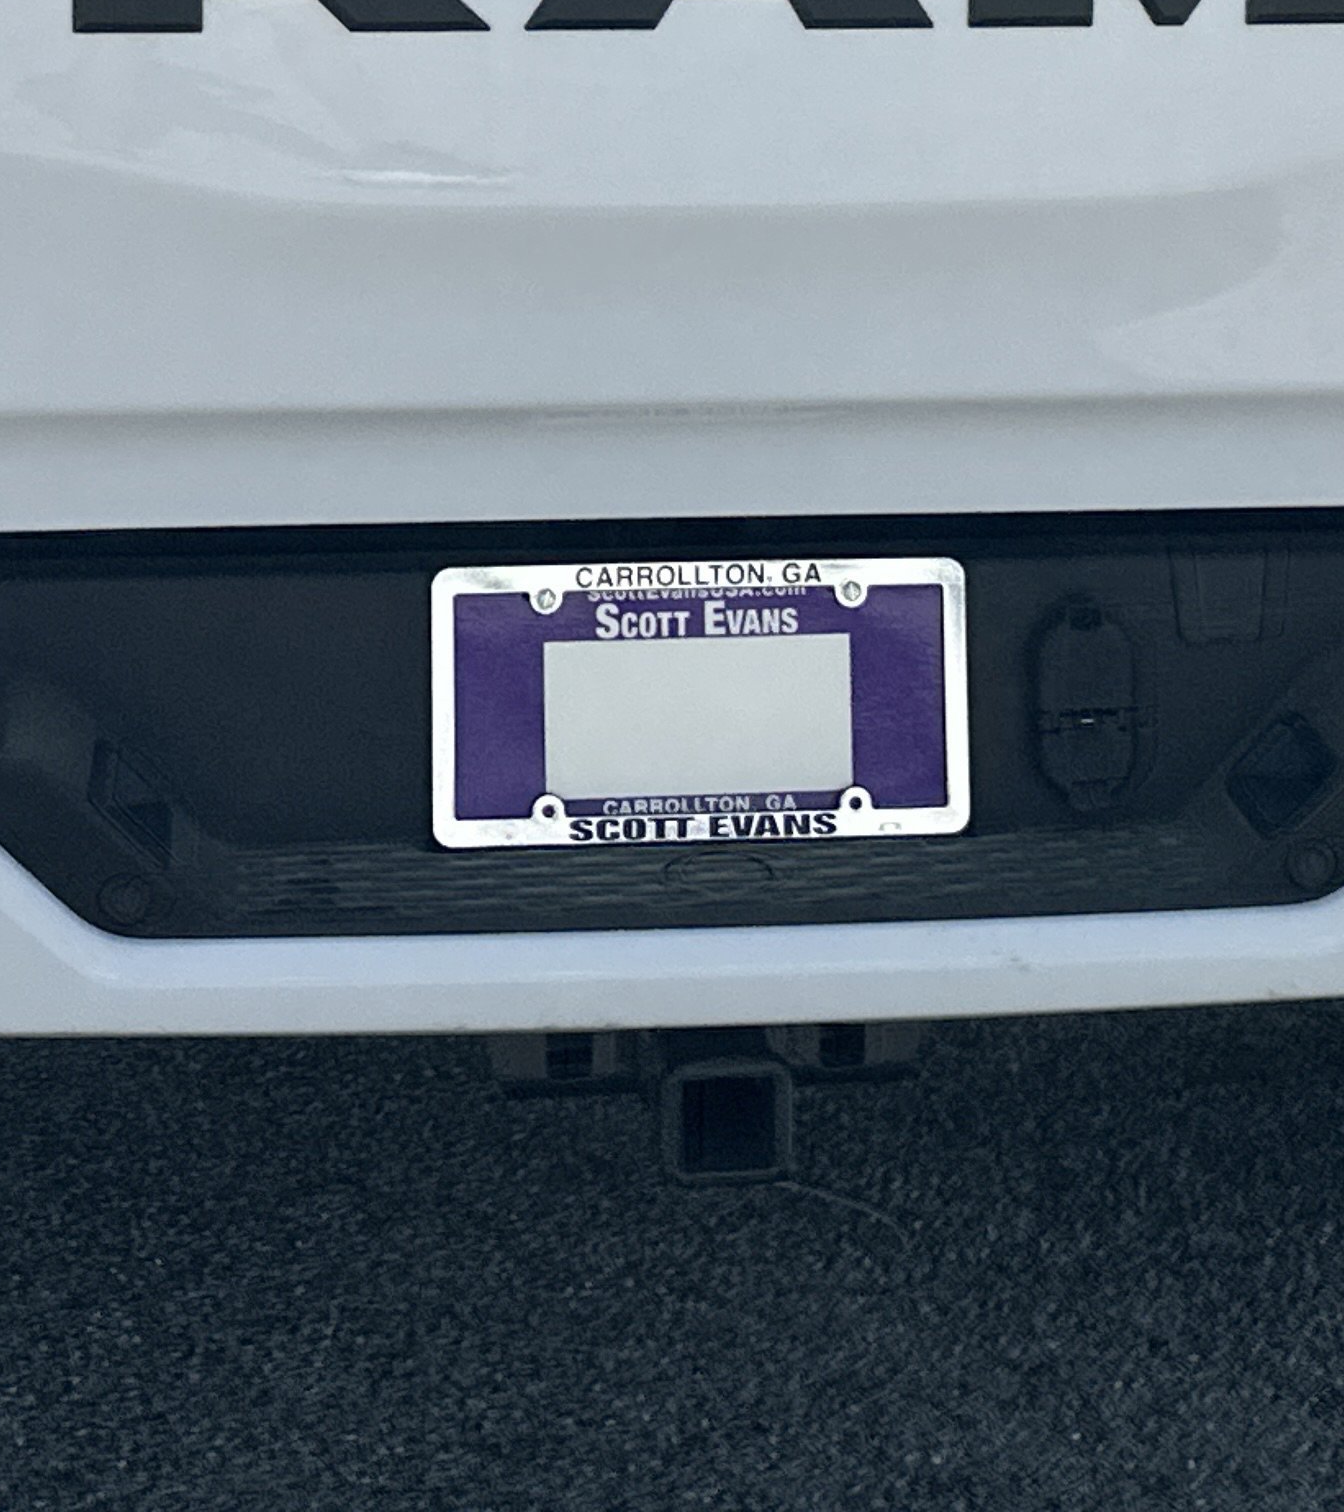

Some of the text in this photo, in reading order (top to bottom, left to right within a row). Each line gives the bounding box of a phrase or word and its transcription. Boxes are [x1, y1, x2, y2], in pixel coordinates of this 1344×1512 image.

[782, 562, 822, 583] GA
[765, 794, 797, 810] GA
[568, 812, 837, 841] SCOTT EVANS
